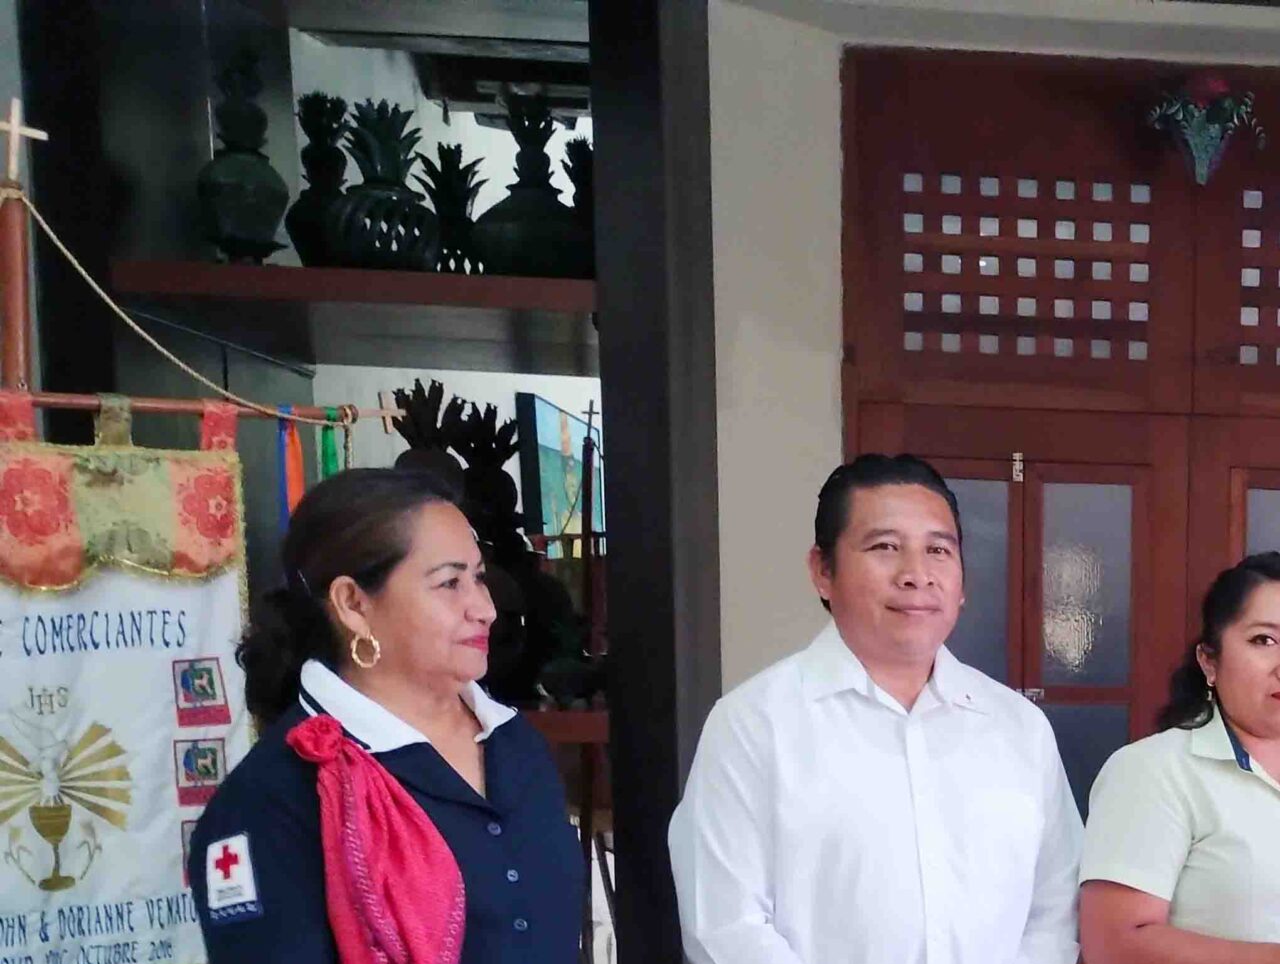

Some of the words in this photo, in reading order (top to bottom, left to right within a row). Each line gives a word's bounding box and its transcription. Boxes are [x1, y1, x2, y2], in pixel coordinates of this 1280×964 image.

[22, 610, 186, 656] COMERCIANTES
[38, 910, 50, 943] &
[57, 901, 134, 940] DORIANNE
